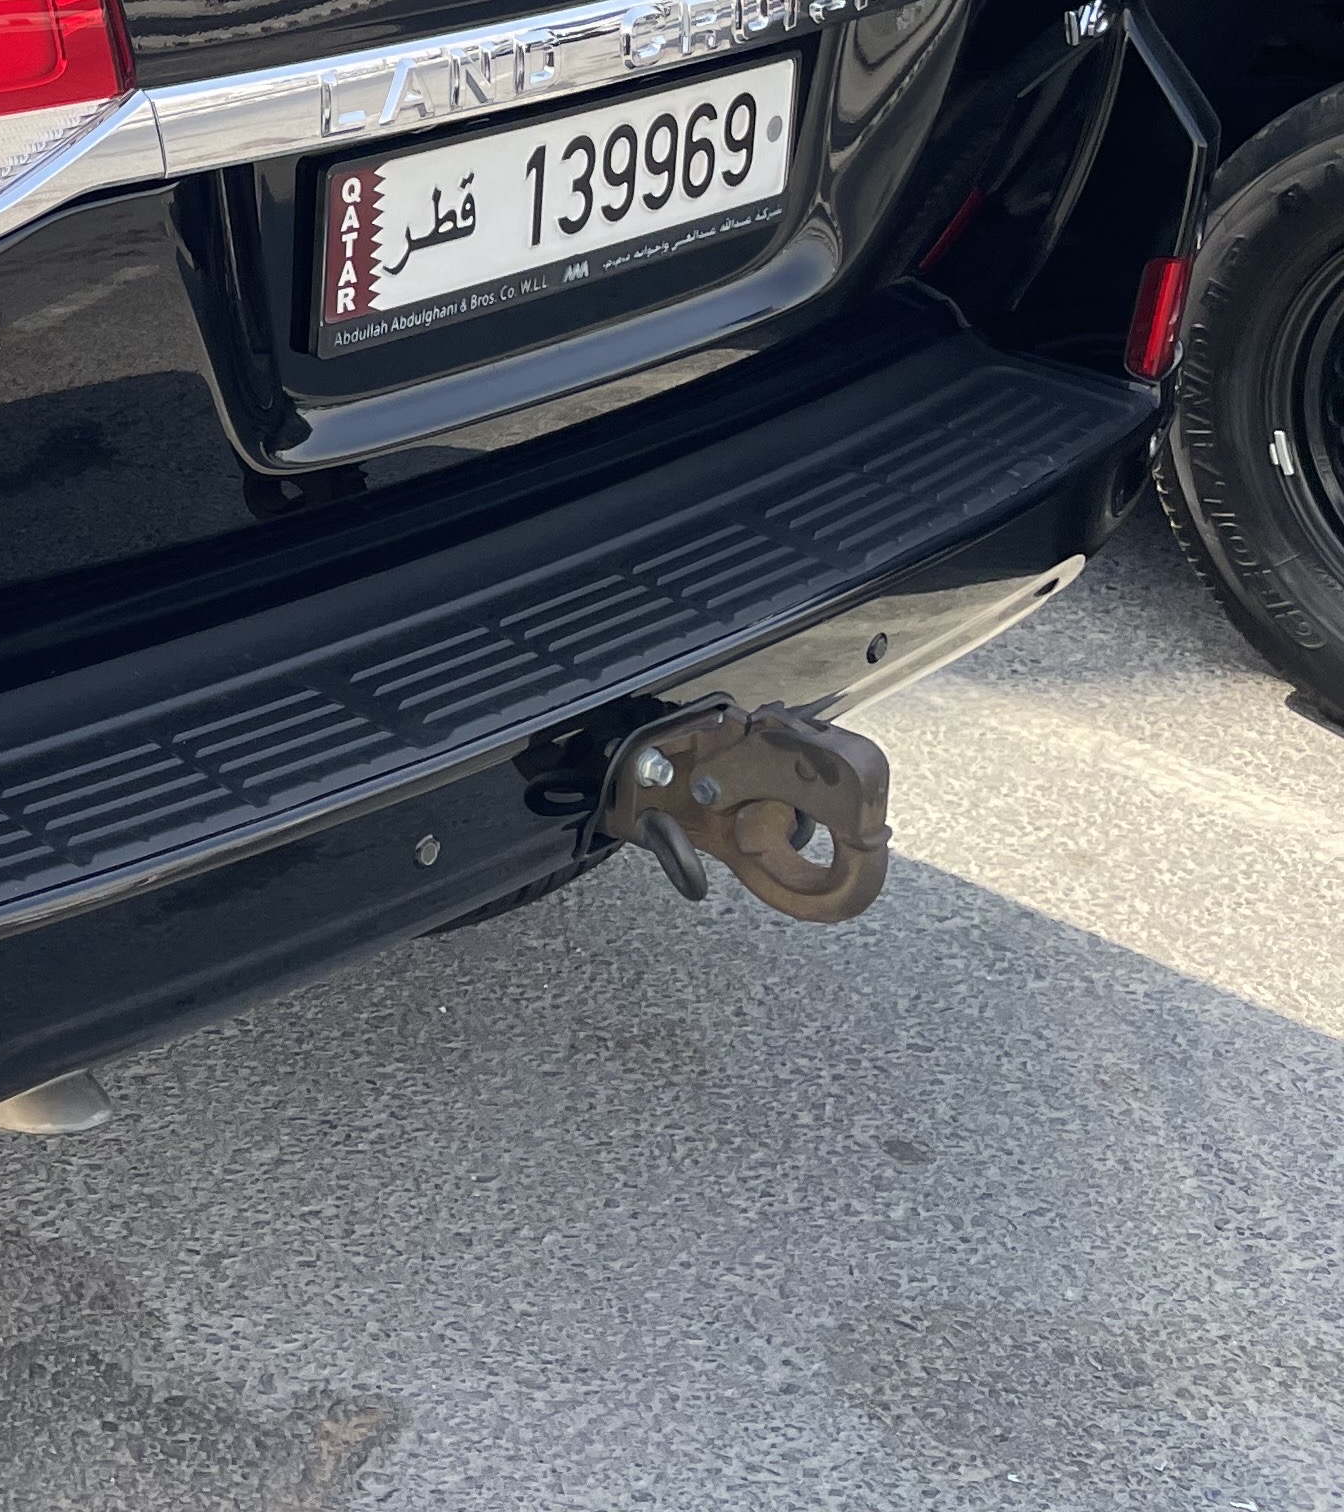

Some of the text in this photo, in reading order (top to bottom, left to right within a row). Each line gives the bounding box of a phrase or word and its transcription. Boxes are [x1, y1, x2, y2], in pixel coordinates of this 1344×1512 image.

[318, 28, 561, 138] LAND
[383, 172, 476, 275] قطر
[524, 93, 758, 246] 139969
[336, 177, 361, 314] QATAR
[334, 321, 388, 347] Abdullah
[391, 304, 458, 333] Abdulghani
[460, 301, 467, 313] &
